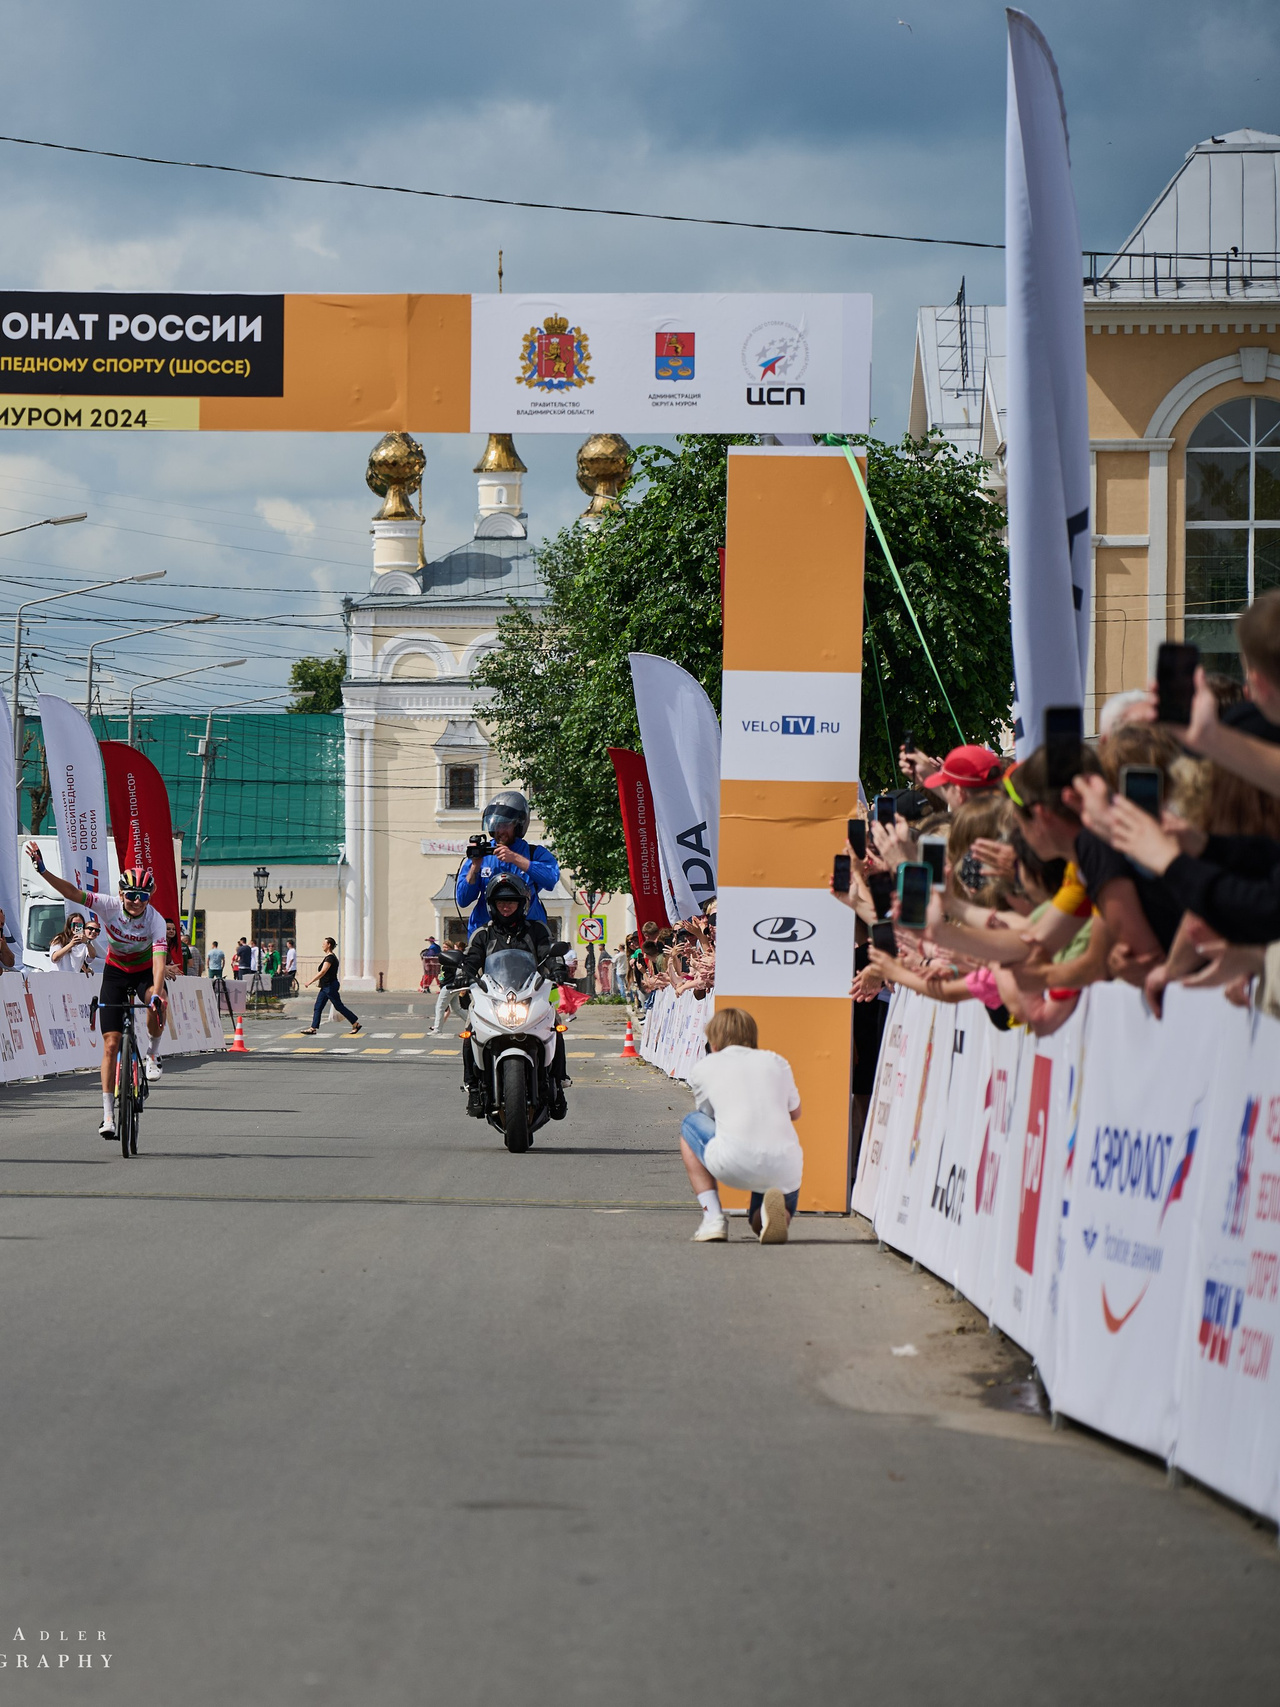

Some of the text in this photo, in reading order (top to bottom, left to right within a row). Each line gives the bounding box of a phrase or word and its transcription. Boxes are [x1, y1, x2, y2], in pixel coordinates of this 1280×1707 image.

[108, 313, 263, 344] РОССИИ
[92, 358, 166, 374] СПОРТУ
[169, 358, 252, 379] (ШОССЕ)
[530, 401, 581, 409] ПРАВИТЕЛЬСТВО
[648, 393, 701, 401] АДМИНИСТРАЦИЯ
[651, 400, 698, 408] ОКРУГА МУРОМ
[746, 386, 806, 406] ЦСП
[90, 408, 148, 429] 2024
[516, 408, 595, 417] ВЛАДИМИРСКОЙ ОБЛАСТИ
[66, 764, 78, 852] ВЕЛОСИПЕДНОГО
[79, 811, 88, 851] СПОРТА
[89, 809, 98, 850] РОССИИ
[127, 772, 144, 870] ЕРАЛЬНЫЙ СПОНСОР
[636, 780, 651, 896] ГЕНЕРАЛЬНЫЙ СПОНСОР
[109, 923, 148, 942] BELARUS
[751, 949, 816, 966] LADA
[1087, 1125, 1174, 1201] АЭРОФЛОТ
